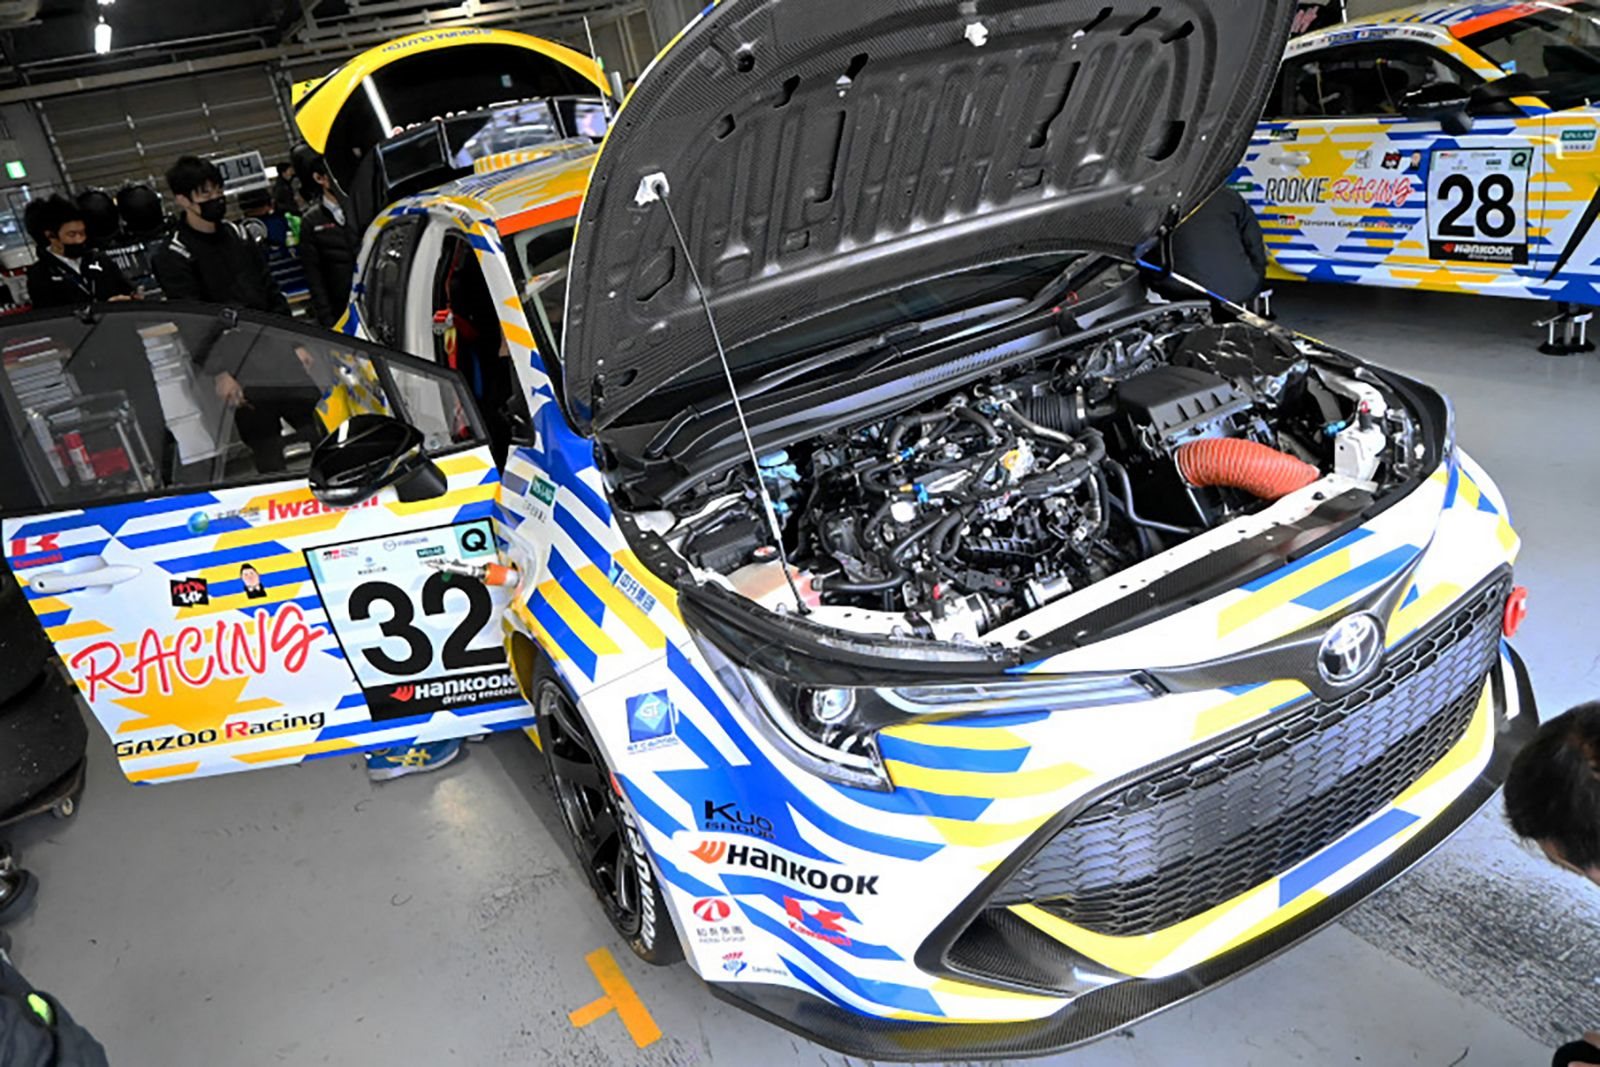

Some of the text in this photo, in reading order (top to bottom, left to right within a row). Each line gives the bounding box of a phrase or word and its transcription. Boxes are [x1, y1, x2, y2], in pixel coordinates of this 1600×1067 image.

[1511, 152, 1527, 167] Q
[1265, 176, 1414, 207] ROOKIE RACING
[1437, 173, 1516, 238] 28
[461, 528, 488, 553] Q
[348, 571, 508, 676] 32
[70, 605, 326, 703] RACING
[113, 711, 325, 757] GAZOO Racing
